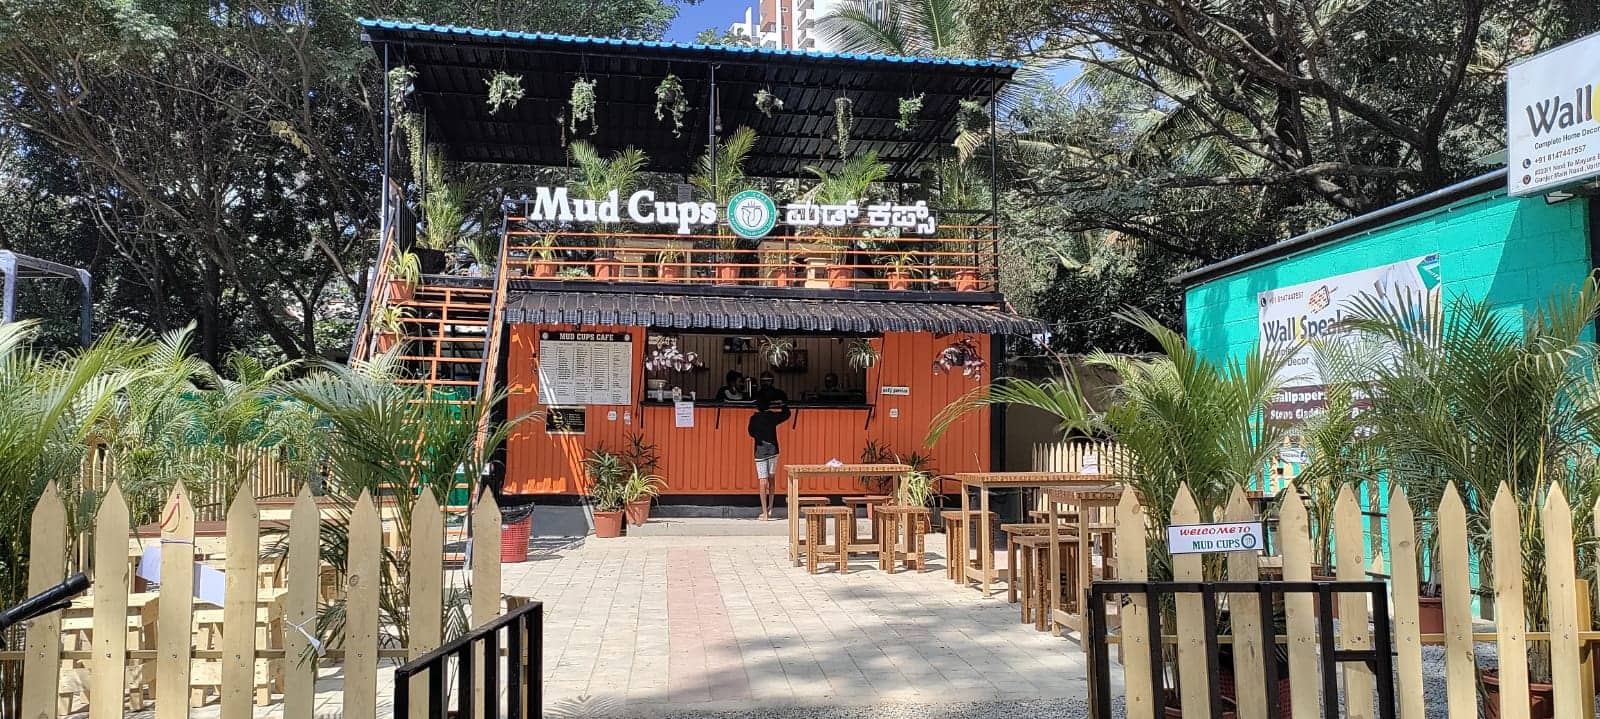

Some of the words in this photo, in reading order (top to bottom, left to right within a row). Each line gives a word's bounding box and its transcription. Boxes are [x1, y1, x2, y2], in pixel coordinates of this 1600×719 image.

[1525, 84, 1592, 137] Wall
[1535, 137, 1562, 150] Complete
[1563, 132, 1581, 142] Home
[1535, 155, 1546, 163] +91
[532, 186, 620, 225] Mud
[627, 190, 717, 235] Cups
[1262, 316, 1296, 343] Wall
[1300, 310, 1353, 341] Spea
[560, 332, 575, 341] MUD
[577, 333, 595, 341] CUPS
[597, 333, 614, 341] CAFE
[1179, 526, 1236, 537] WELCOME
[1238, 525, 1251, 534] TO
[1192, 540, 1214, 551] MUD
[1216, 538, 1241, 550] CUPS
